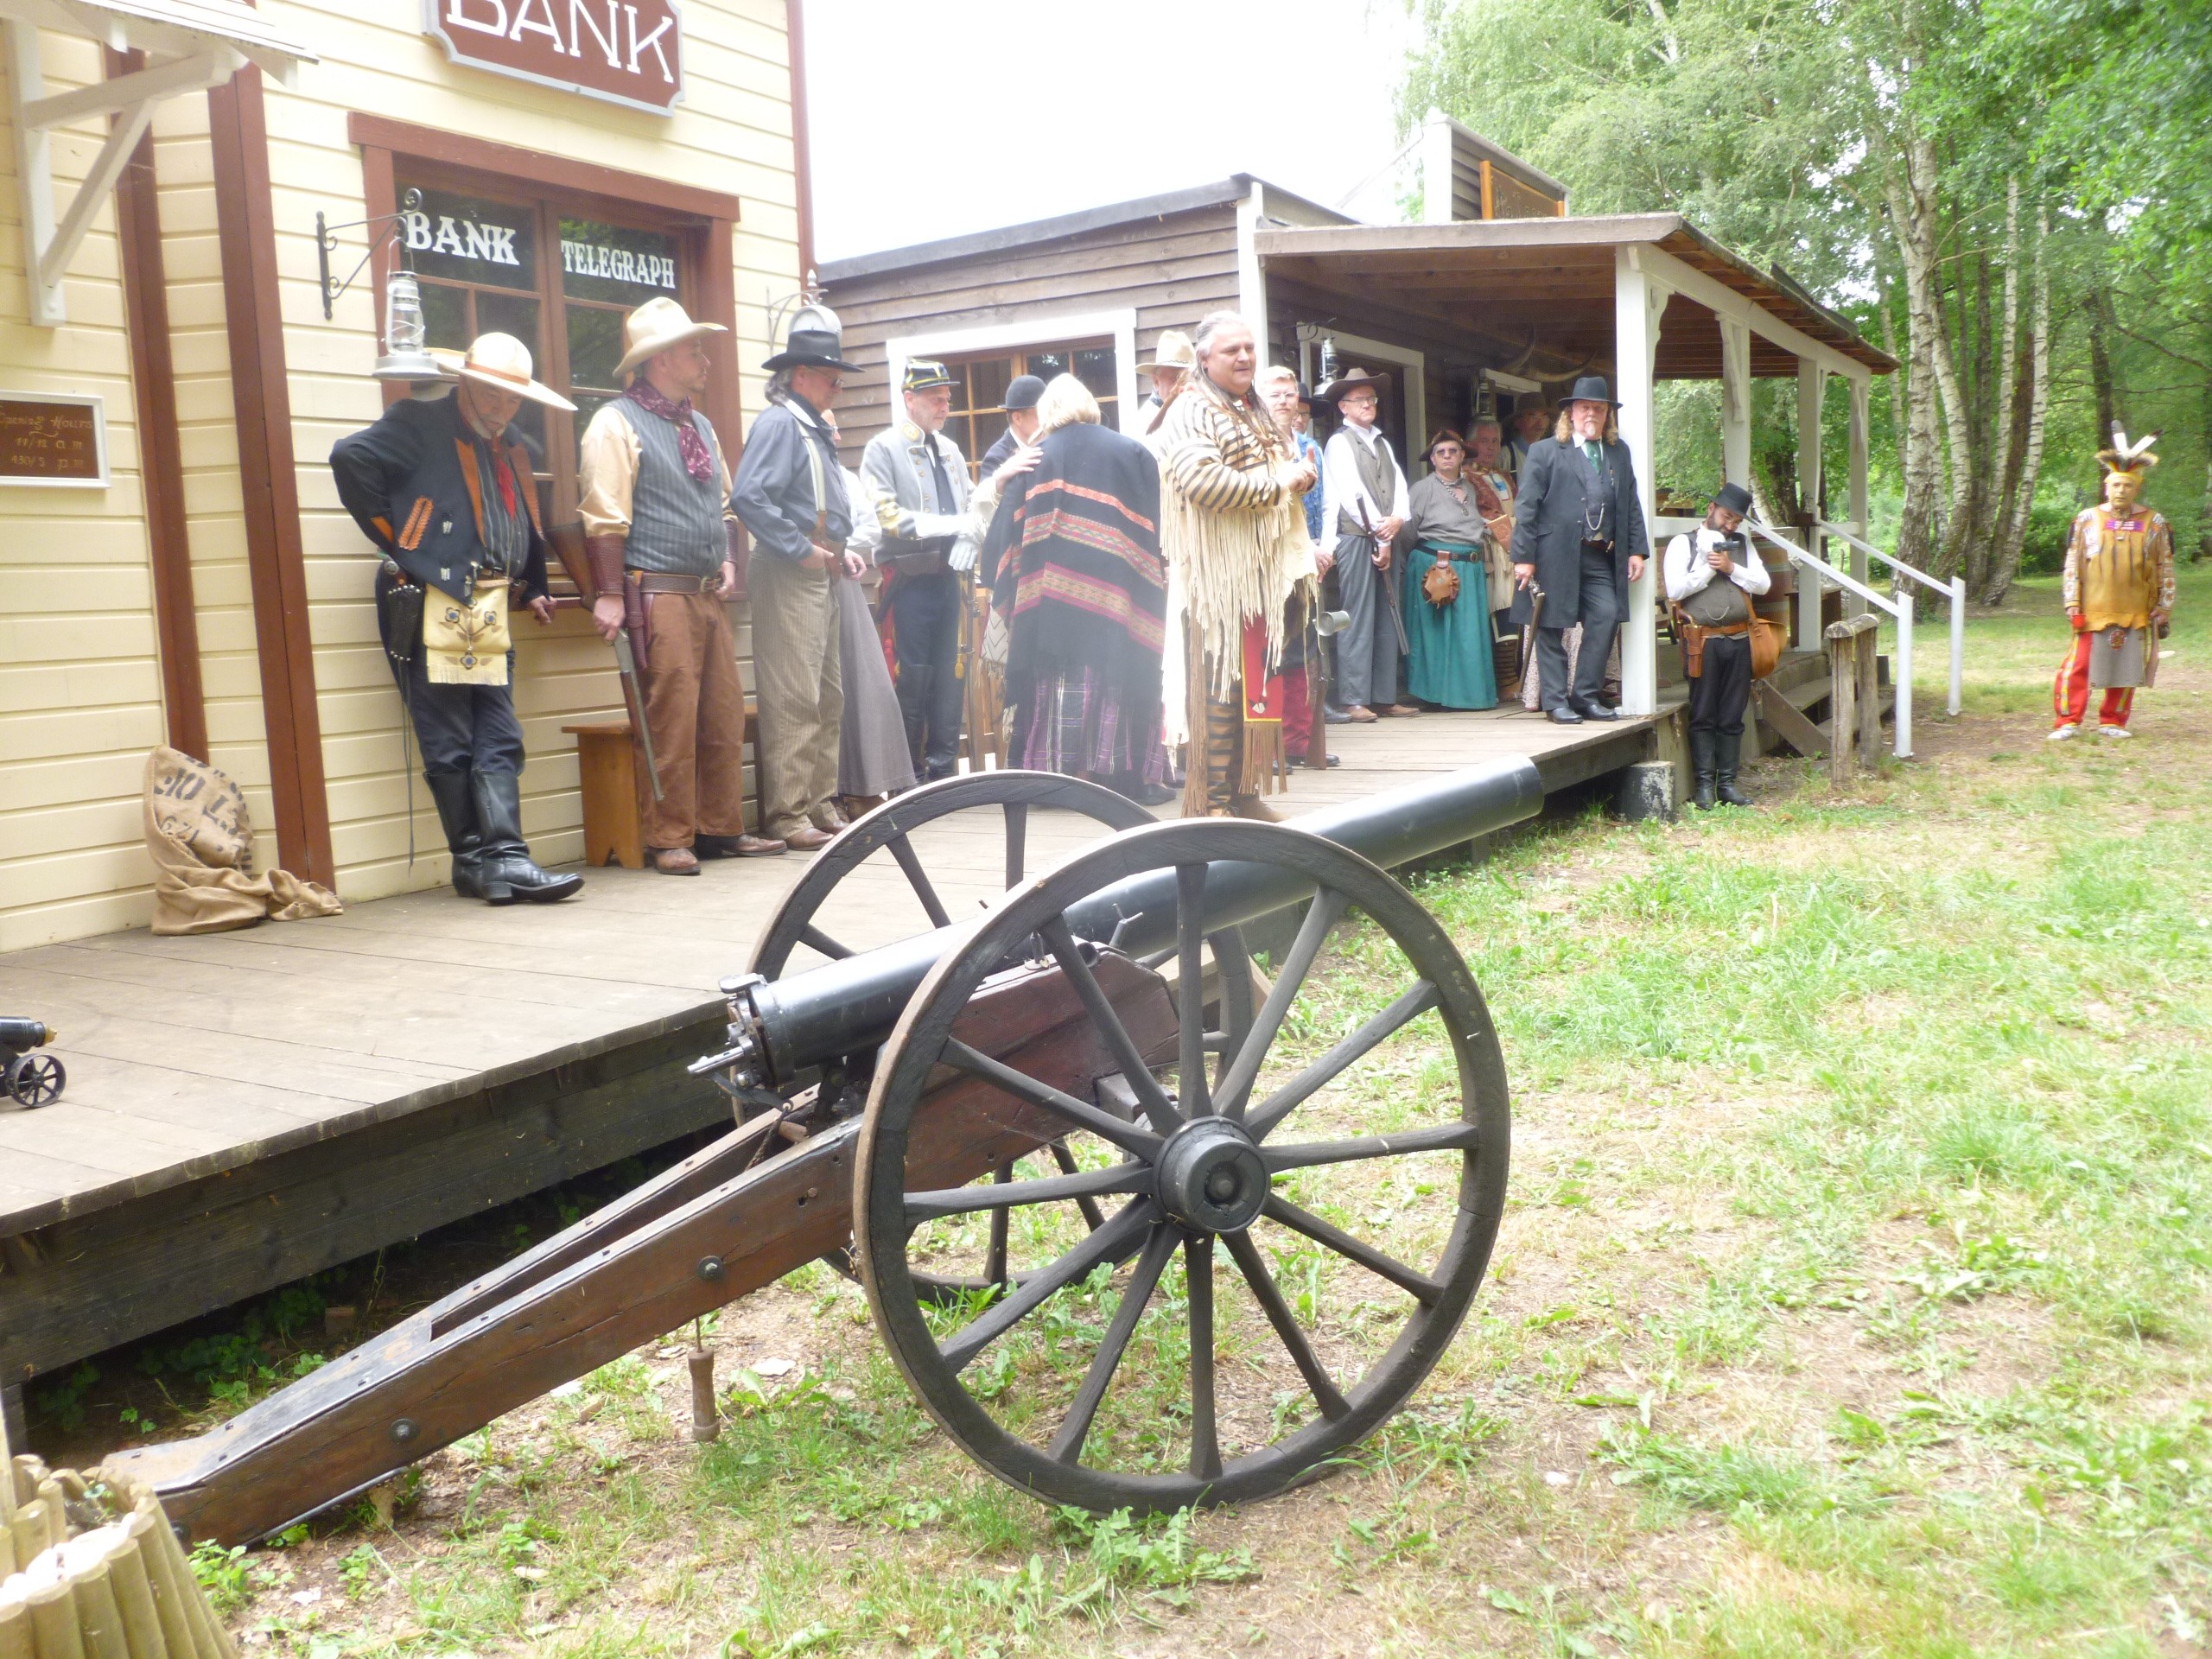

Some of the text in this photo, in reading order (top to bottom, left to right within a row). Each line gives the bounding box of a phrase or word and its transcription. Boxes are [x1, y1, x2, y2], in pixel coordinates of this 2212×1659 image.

[403, 209, 520, 266] BANK
[560, 239, 676, 289] TELEGRAPH
[49, 415, 93, 429] Hours
